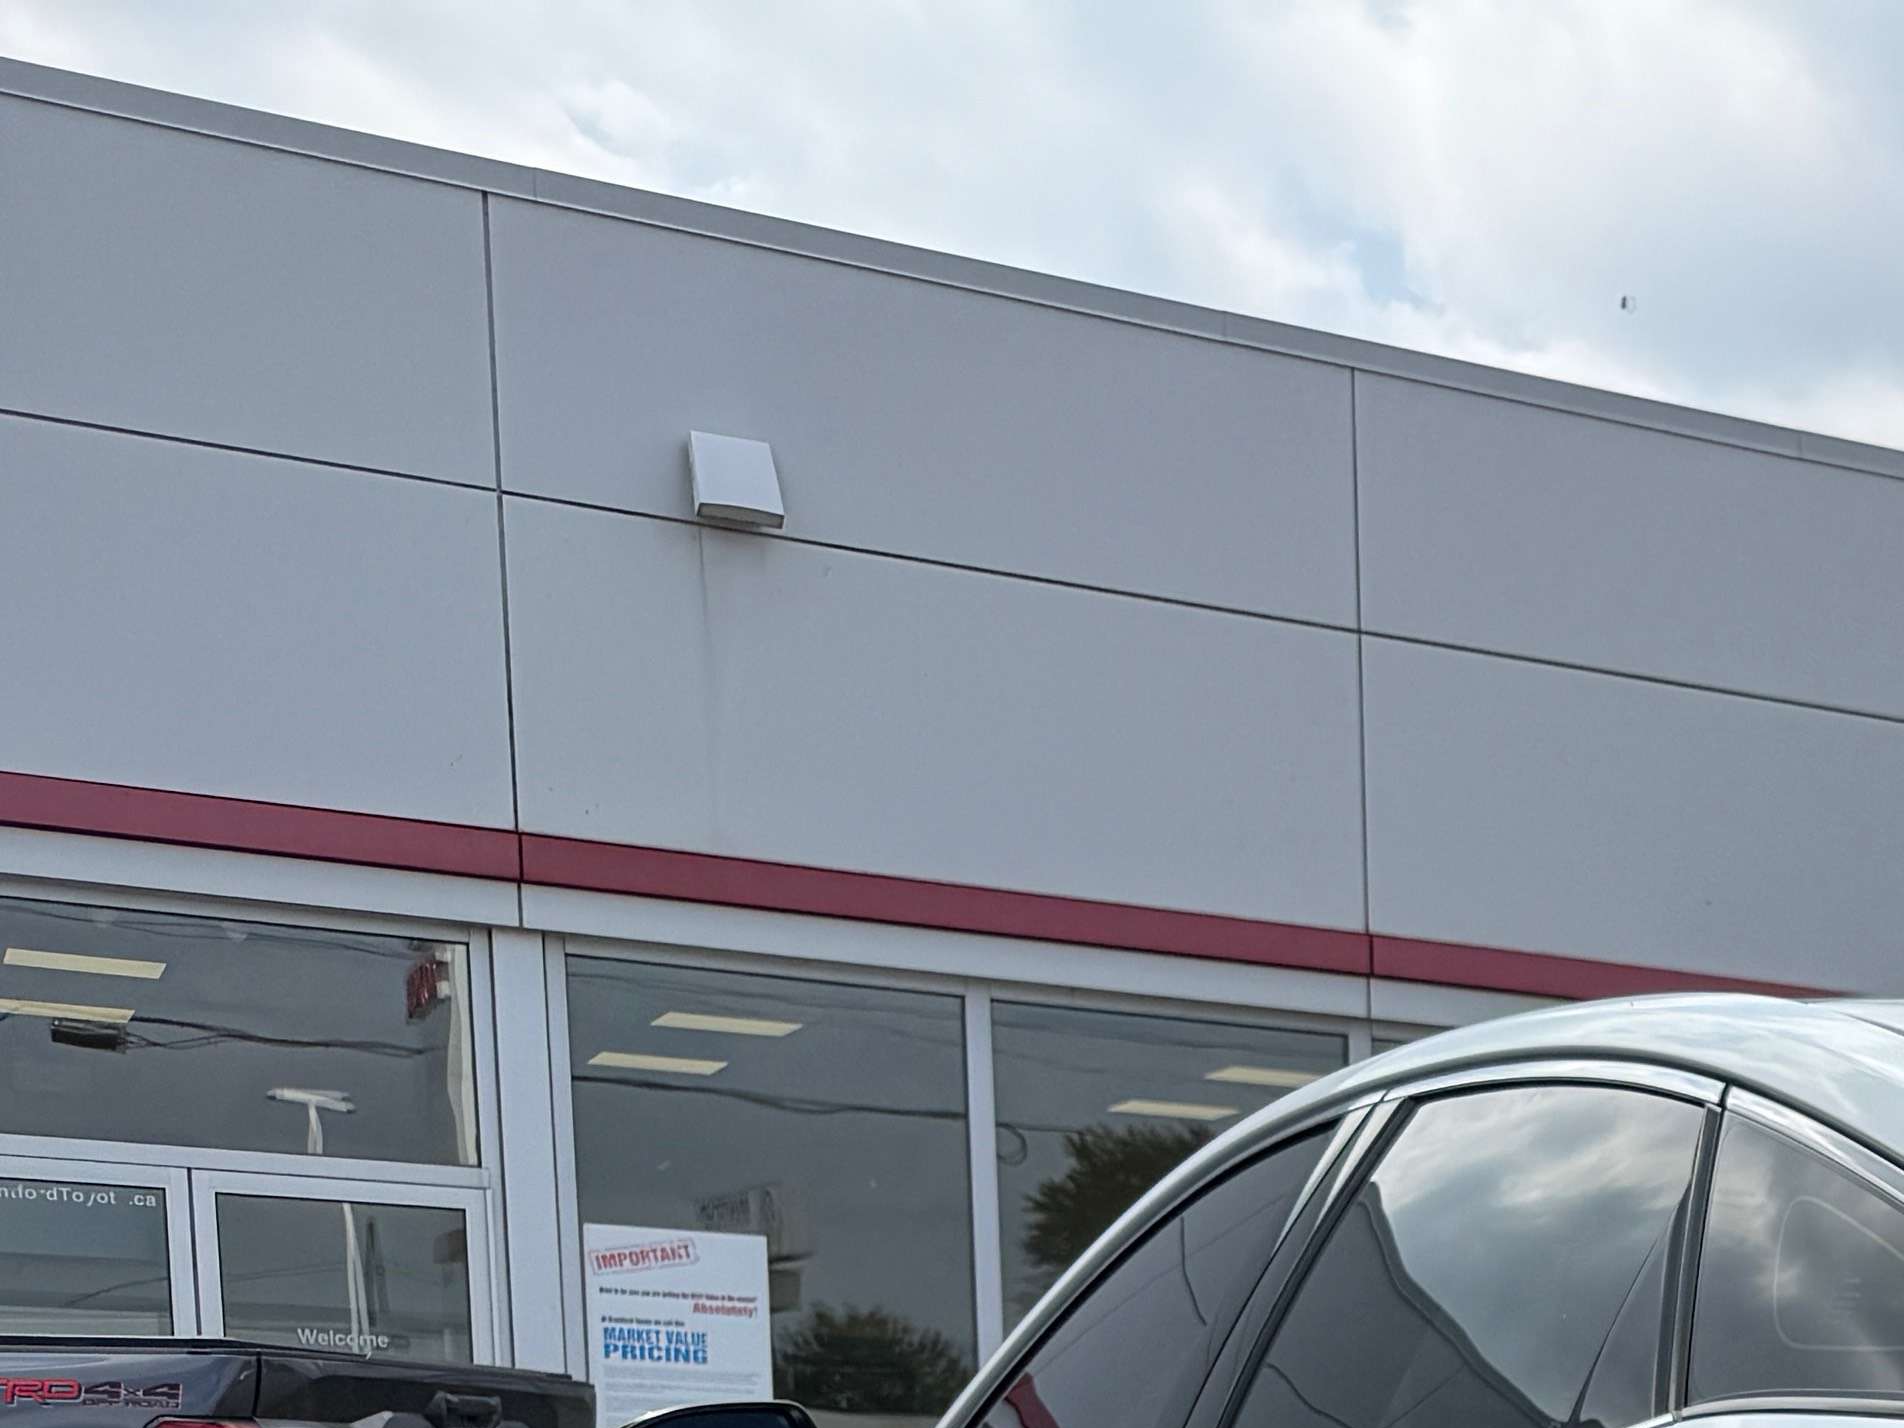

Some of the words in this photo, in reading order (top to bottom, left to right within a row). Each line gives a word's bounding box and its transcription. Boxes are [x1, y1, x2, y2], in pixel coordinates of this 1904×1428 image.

[594, 1244, 693, 1271] IMPORTANT
[297, 1327, 389, 1348] Welcome
[603, 1327, 660, 1344] MARKET
[665, 1330, 707, 1347] VALUE
[603, 1343, 708, 1364] PRICING
